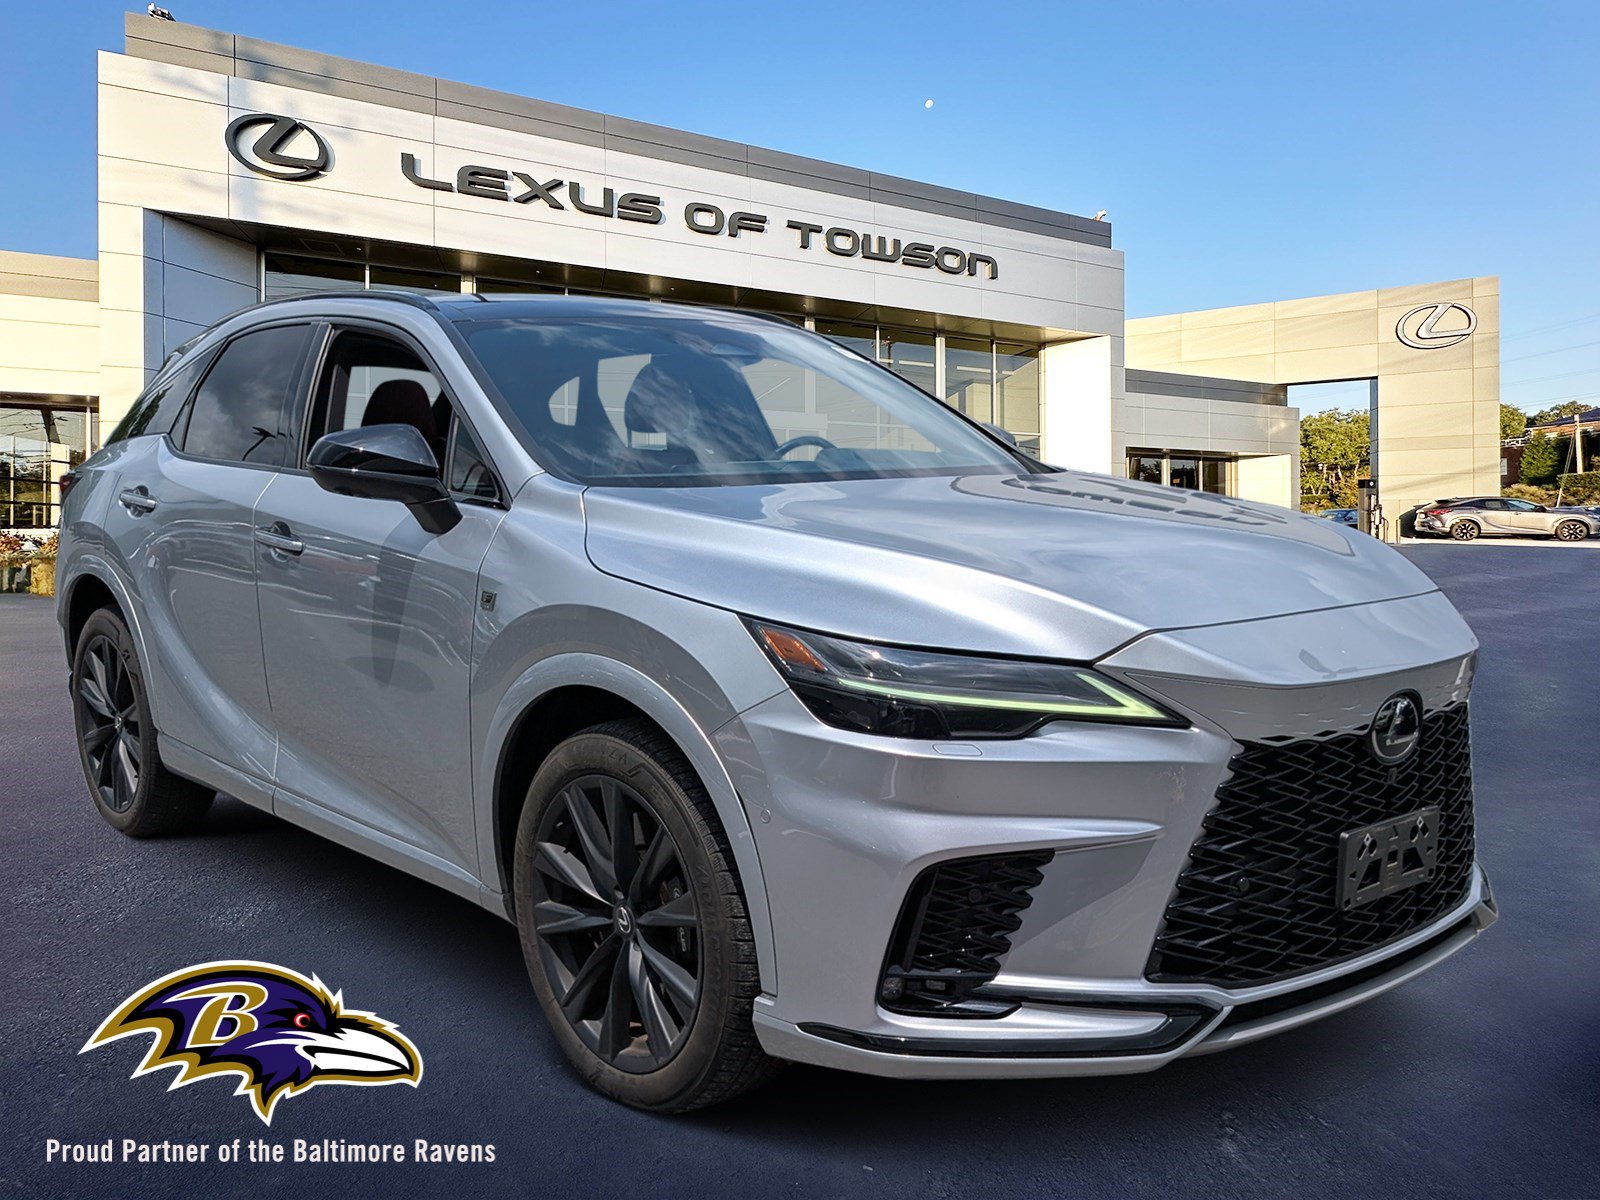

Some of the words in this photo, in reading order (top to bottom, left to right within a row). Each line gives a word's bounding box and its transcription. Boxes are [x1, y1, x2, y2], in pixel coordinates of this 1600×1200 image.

[400, 152, 663, 226] LEXUS
[684, 201, 768, 238] OF
[786, 219, 1000, 281] TOWSON
